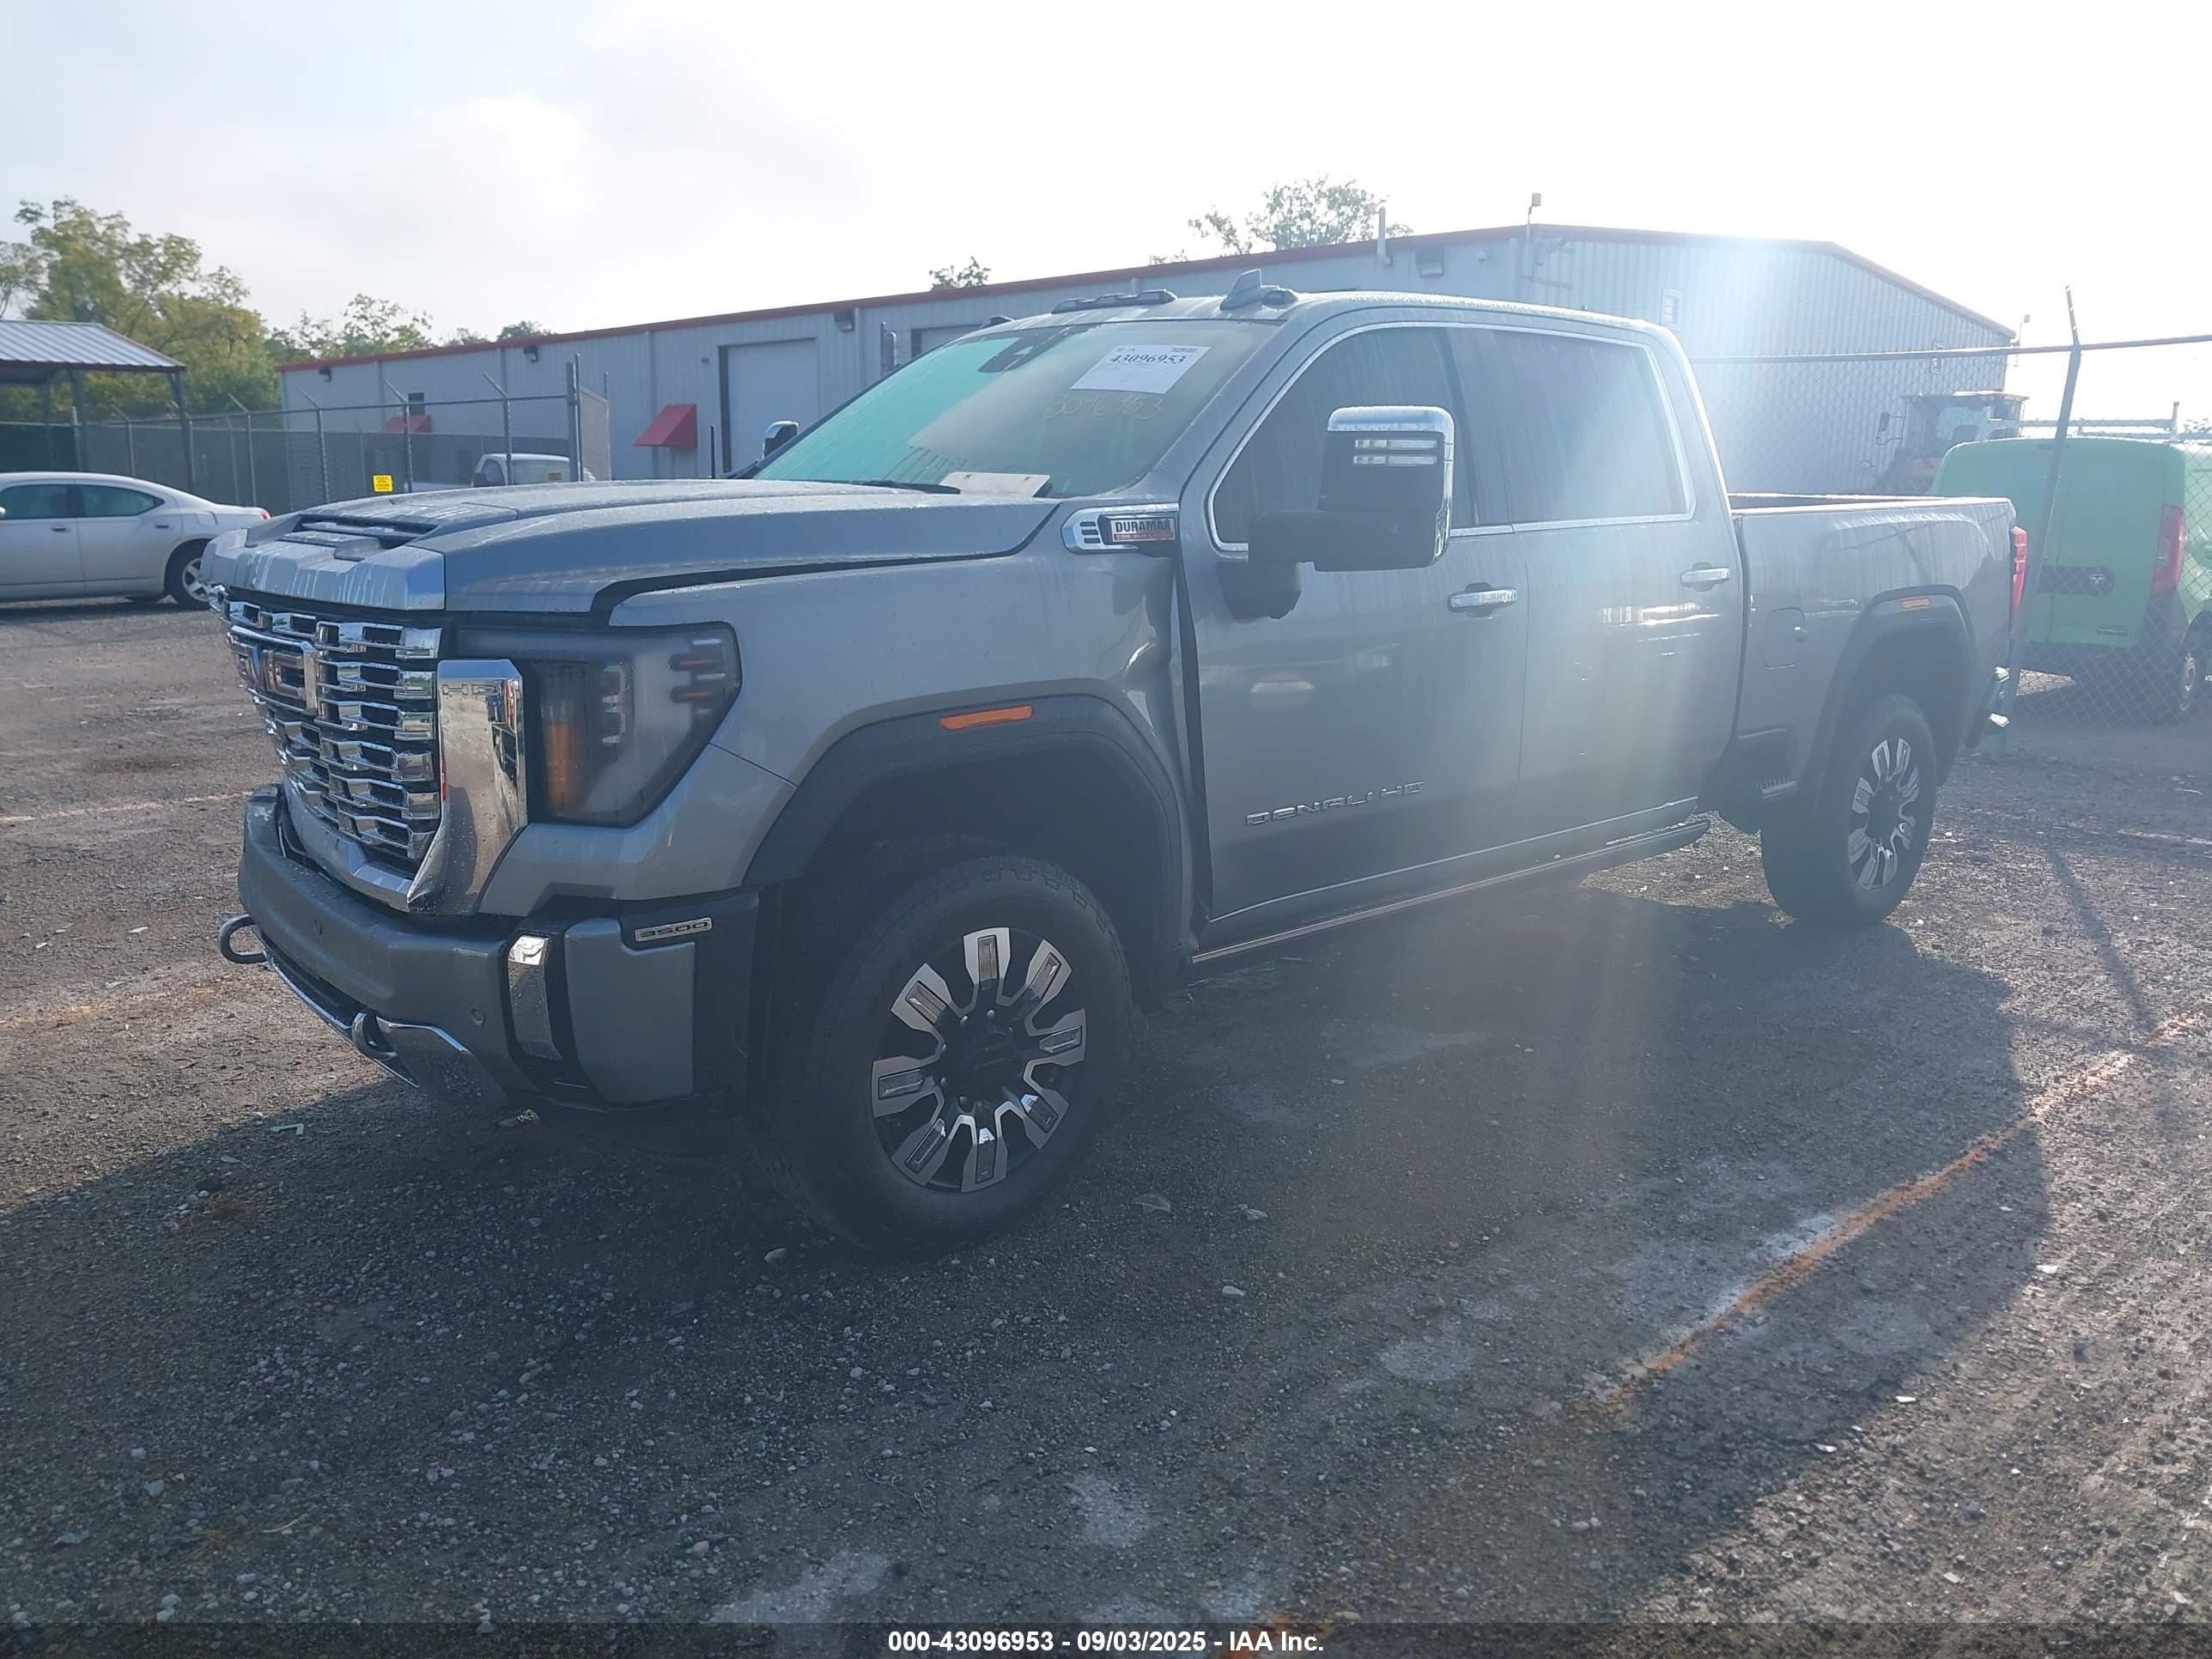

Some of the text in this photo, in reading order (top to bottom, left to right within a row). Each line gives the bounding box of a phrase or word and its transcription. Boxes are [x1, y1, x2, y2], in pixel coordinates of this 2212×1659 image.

[1109, 353, 1187, 365] 43096953
[1115, 520, 1171, 533] DURAMAX
[1245, 781, 1425, 826] DENALI HD
[638, 921, 709, 938] 3500
